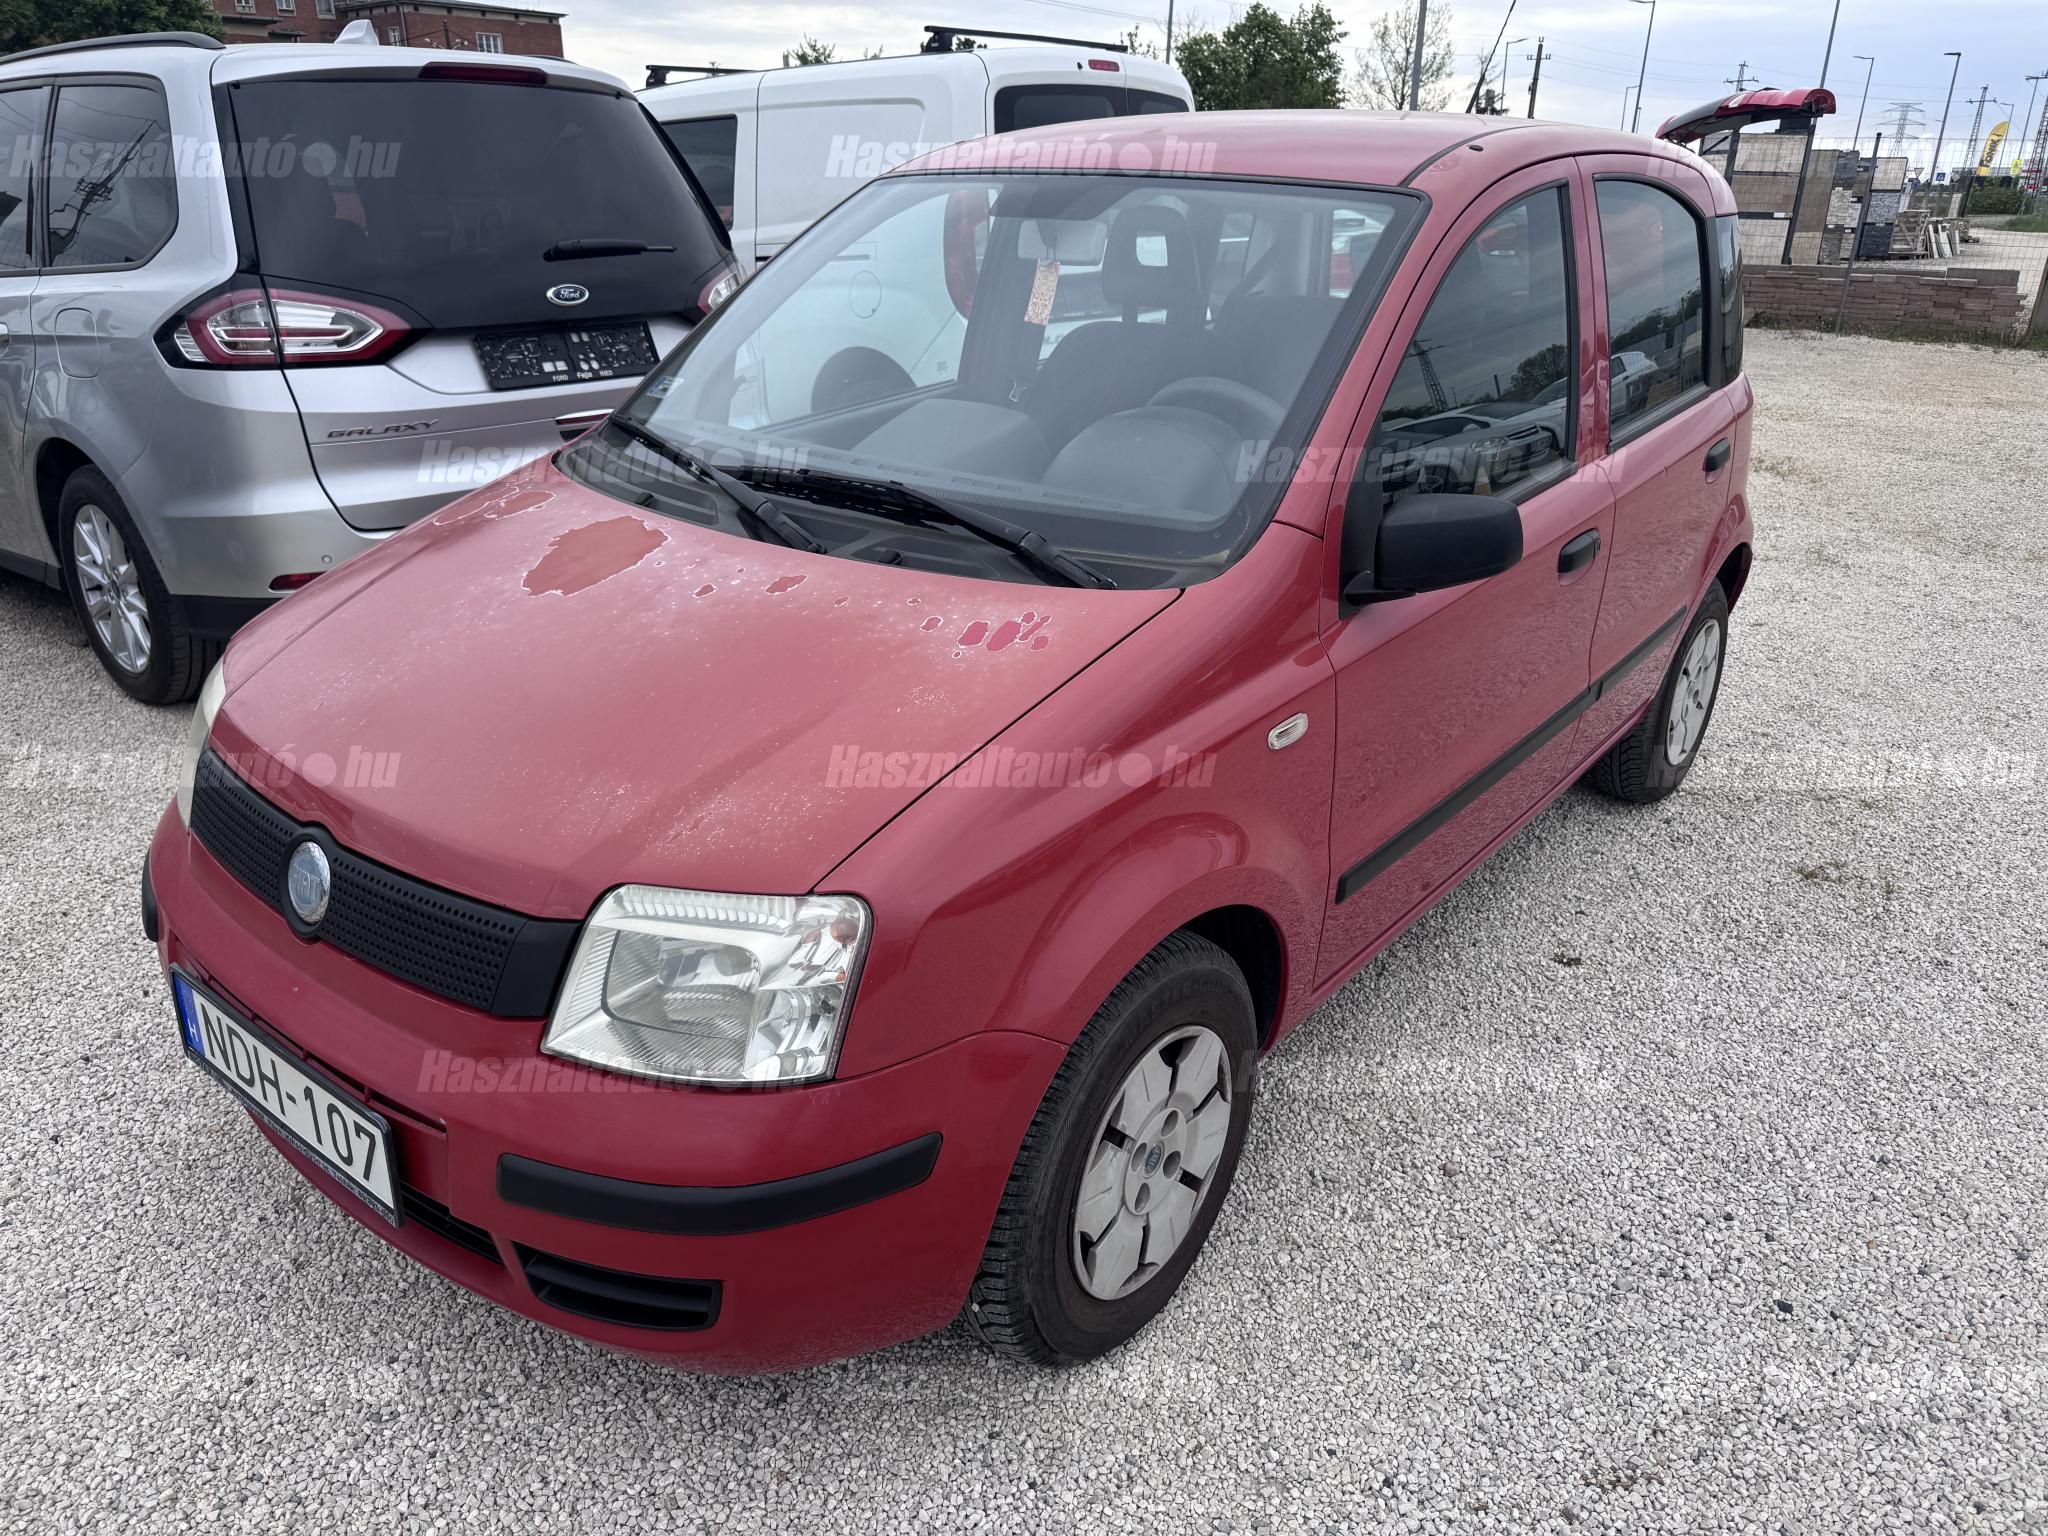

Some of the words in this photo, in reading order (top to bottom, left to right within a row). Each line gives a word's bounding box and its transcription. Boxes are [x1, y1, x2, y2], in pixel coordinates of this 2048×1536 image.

[327, 419, 439, 438] GALAXY
[187, 1018, 199, 1042] H
[201, 1003, 377, 1183] NDH-107
